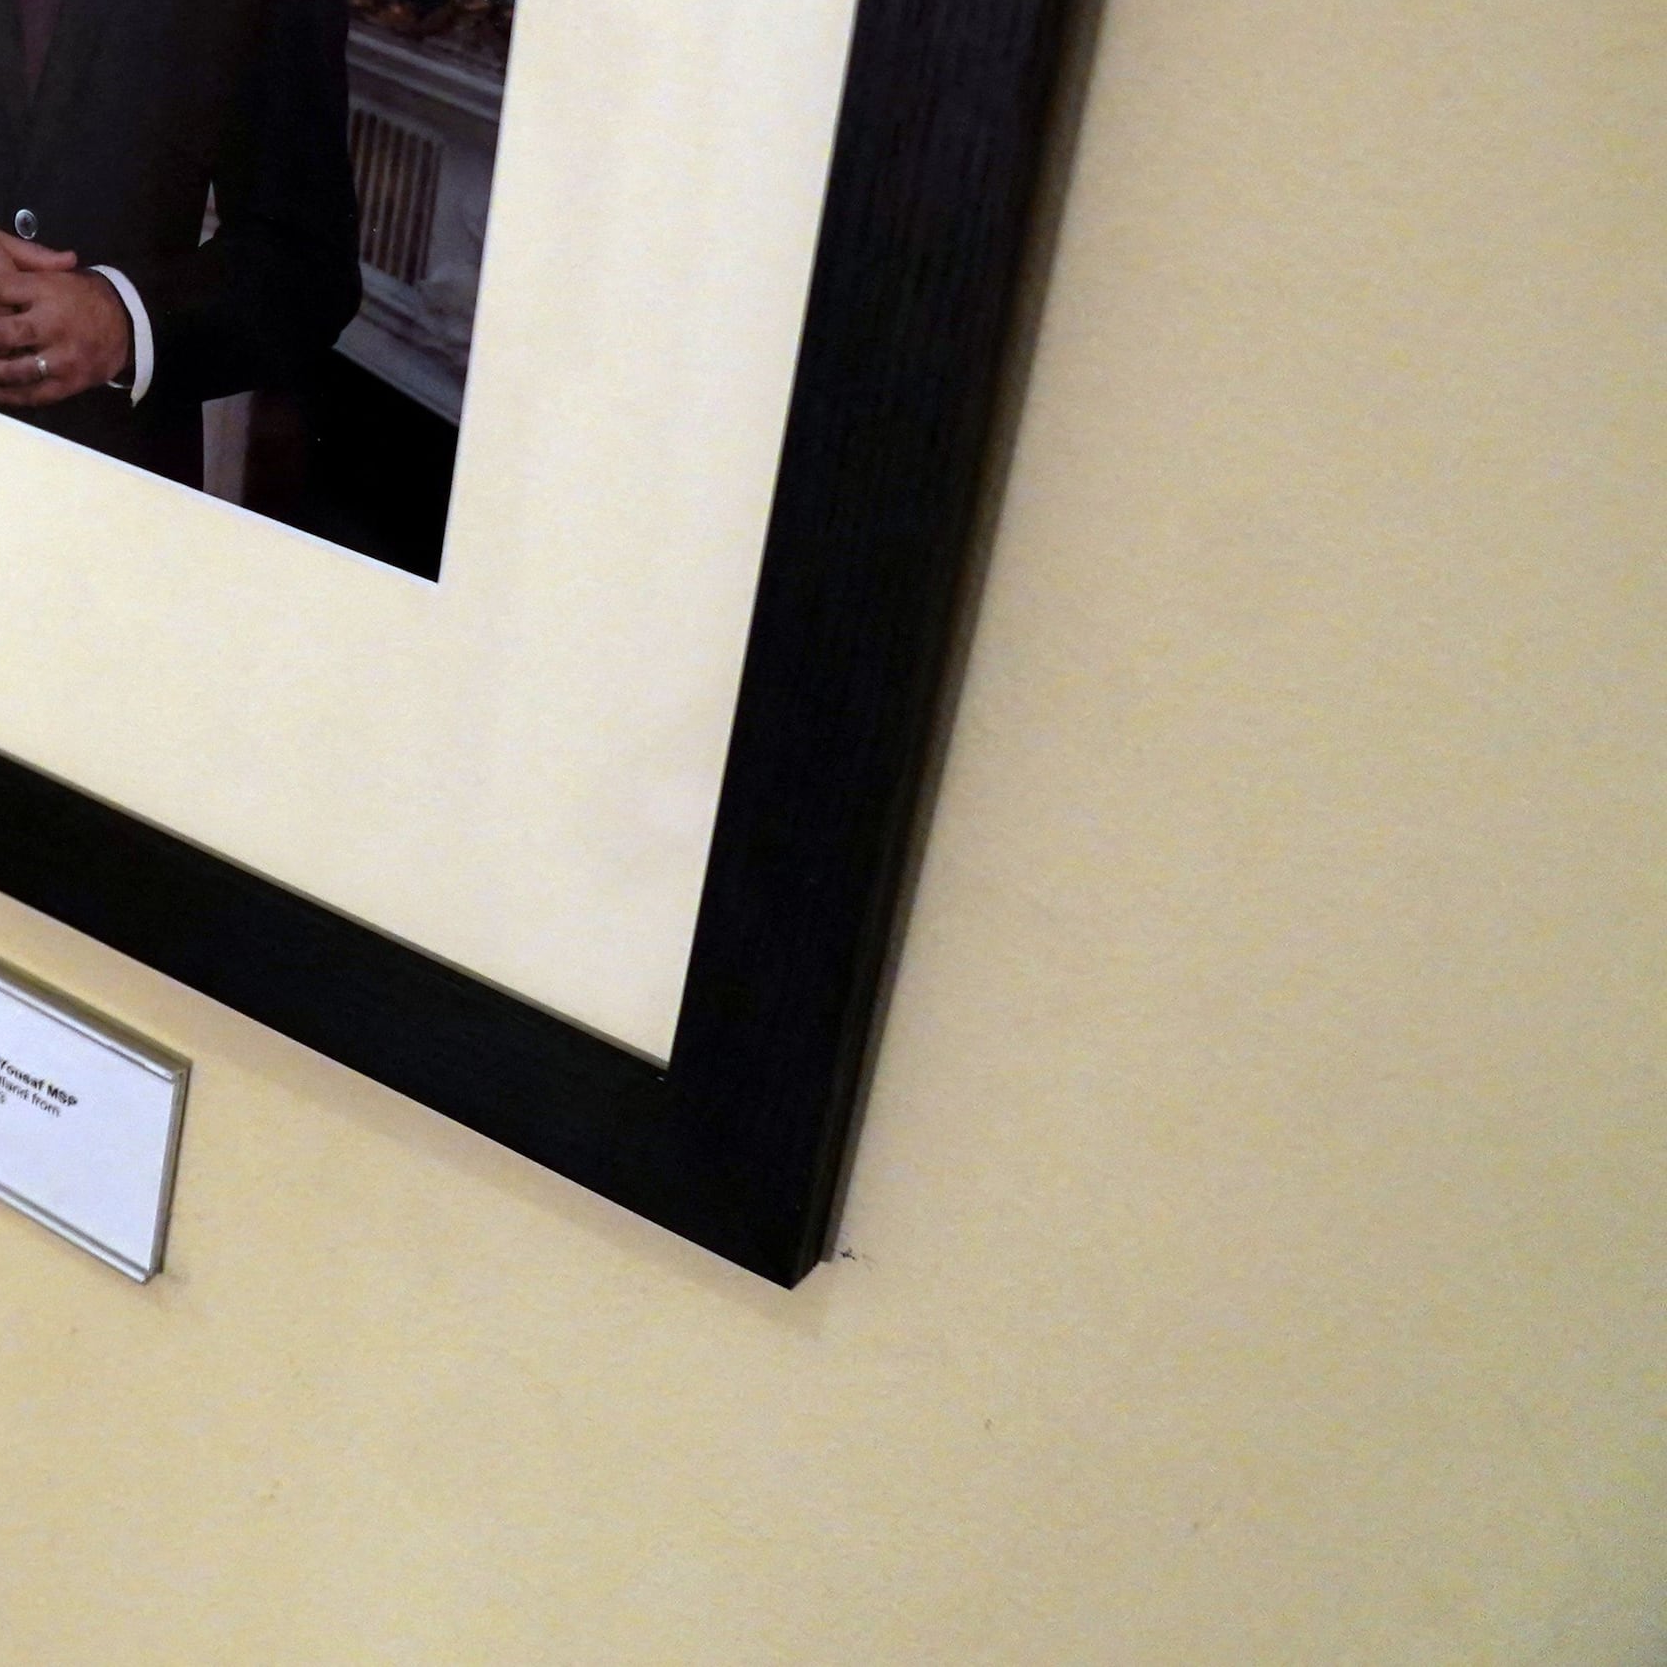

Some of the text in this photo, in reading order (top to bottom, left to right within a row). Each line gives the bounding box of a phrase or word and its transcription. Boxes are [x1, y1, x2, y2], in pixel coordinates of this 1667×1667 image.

[0, 1057, 44, 1090] Yousaf
[47, 1084, 78, 1106] MSP
[32, 1093, 60, 1117] from
